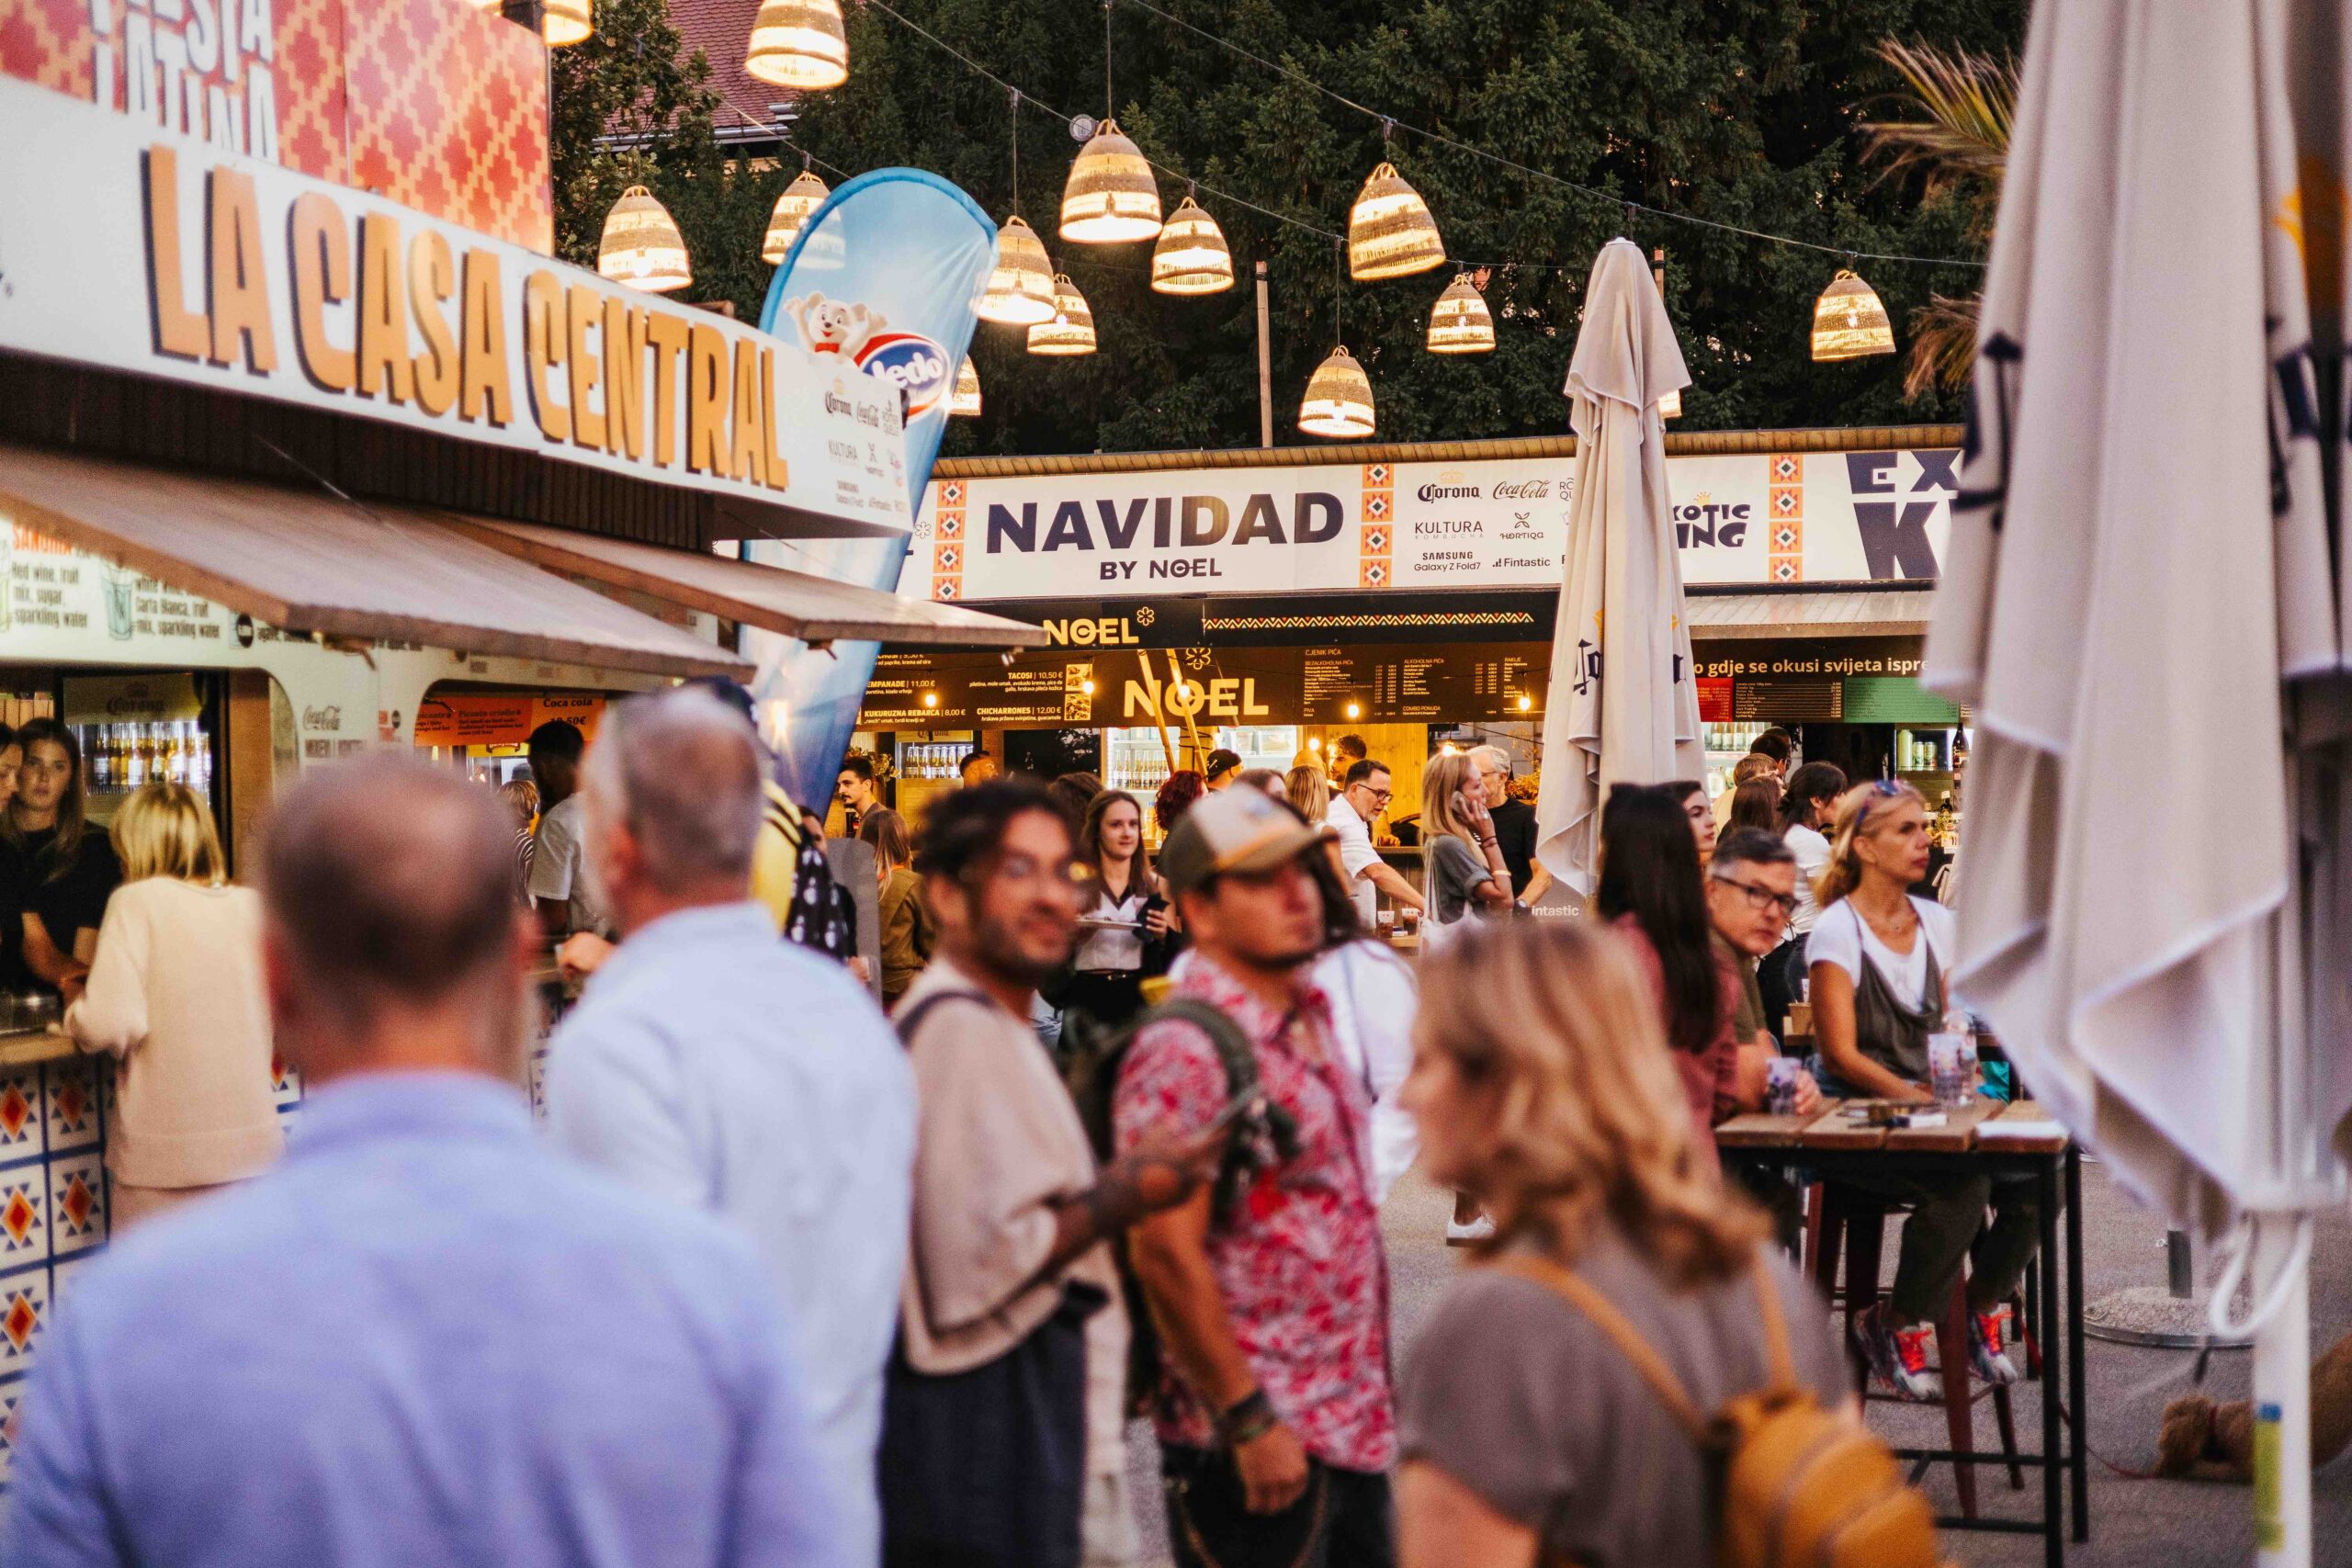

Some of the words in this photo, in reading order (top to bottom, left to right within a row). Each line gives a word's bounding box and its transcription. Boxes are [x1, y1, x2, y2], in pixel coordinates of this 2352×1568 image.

[140, 142, 277, 378] LA
[287, 191, 514, 429] CASA
[523, 269, 789, 492] CENTRAL
[1418, 483, 1480, 503] Corona
[986, 491, 1344, 553] NAVIDAD
[1415, 521, 1483, 534] KULTURA
[1675, 521, 1747, 549] ING
[1422, 551, 1474, 560] SAMSUNG
[1099, 561, 1138, 580] BY
[1149, 558, 1223, 579] NOEL
[1414, 563, 1448, 576] Galaxy
[1456, 562, 1481, 570] Fold7
[1504, 557, 1551, 567] Fintastic
[1043, 617, 1139, 645] NOEL
[1708, 660, 1745, 677] gdje
[1748, 661, 1768, 673] se
[1772, 658, 1820, 673] okusi
[1825, 659, 1883, 675] svijeta
[1887, 658, 1930, 674] ispre
[544, 698, 568, 707] Coca
[571, 698, 593, 707] cola
[1124, 678, 1270, 717] NOEL
[1532, 905, 1579, 917] intastic
